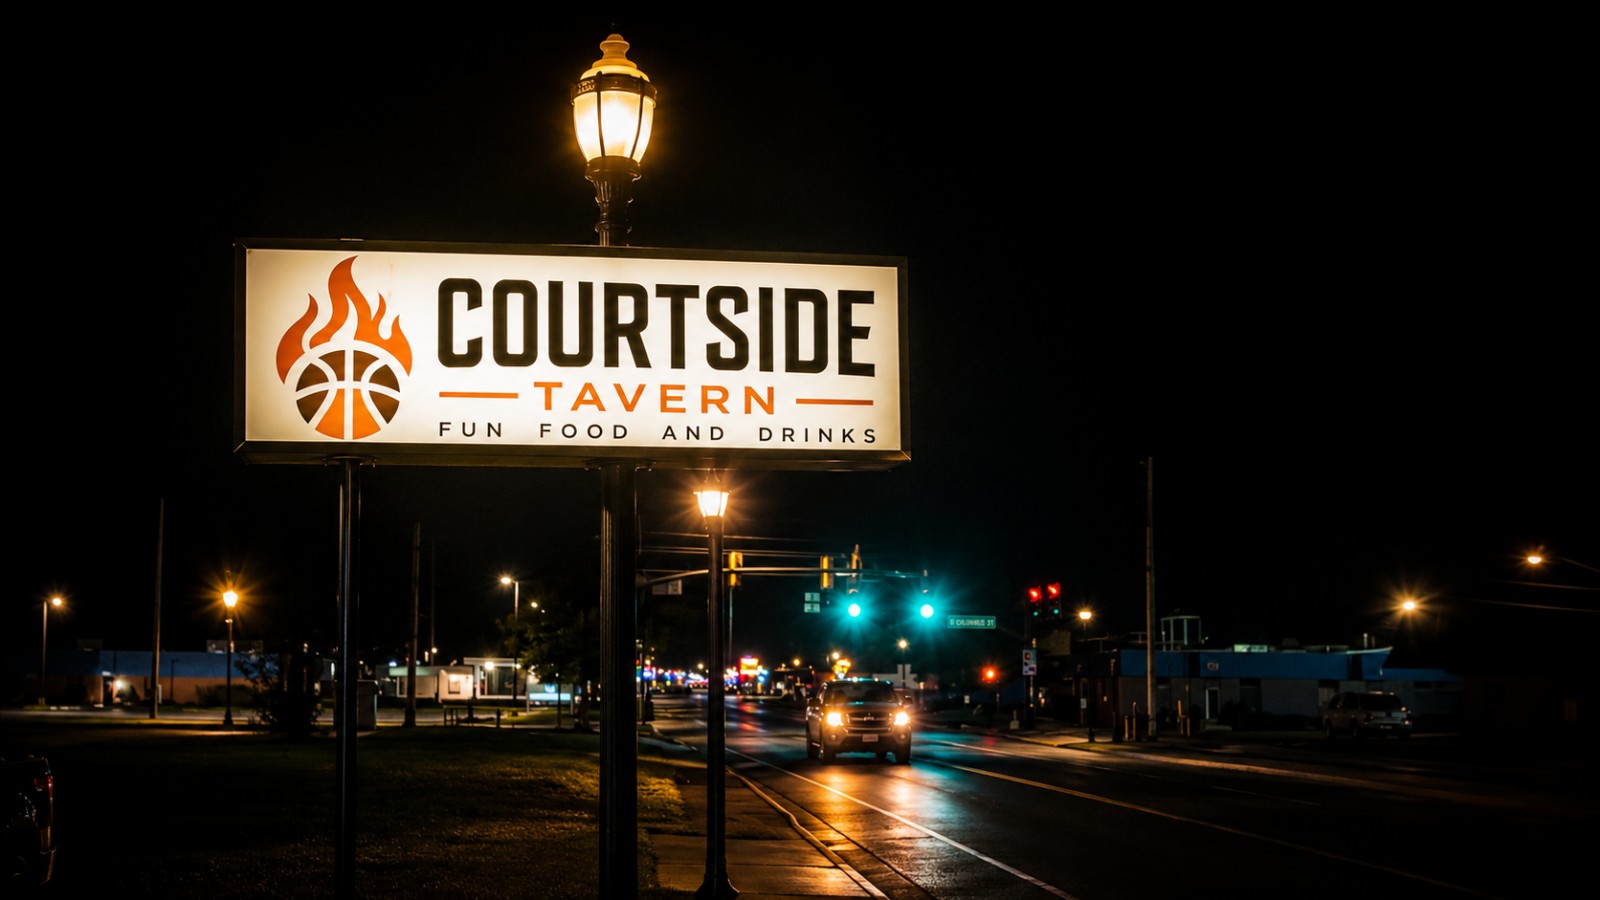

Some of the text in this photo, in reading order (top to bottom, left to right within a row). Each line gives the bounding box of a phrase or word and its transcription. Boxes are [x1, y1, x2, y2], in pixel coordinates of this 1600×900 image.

[437, 277, 876, 378] COURTSIDE
[533, 381, 775, 415] TAVERN
[439, 421, 877, 444] FUN FOOD AND DRINKS
